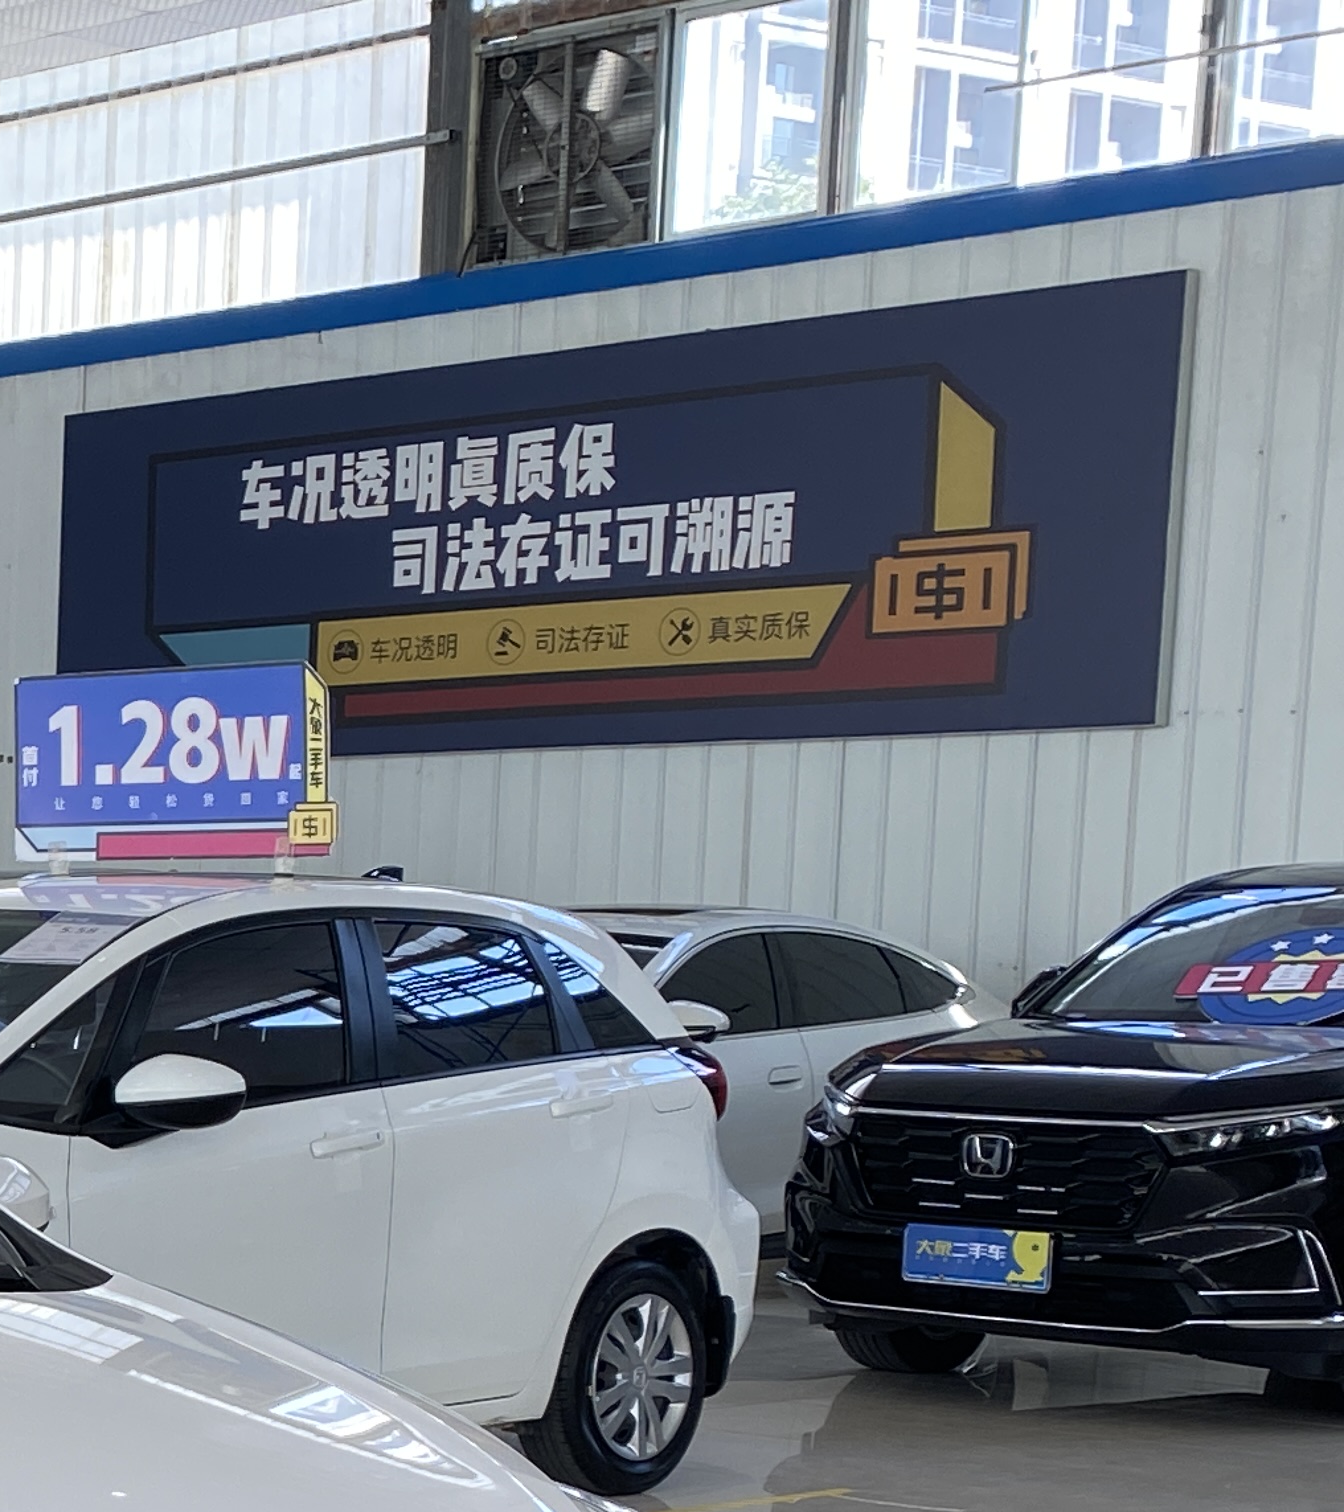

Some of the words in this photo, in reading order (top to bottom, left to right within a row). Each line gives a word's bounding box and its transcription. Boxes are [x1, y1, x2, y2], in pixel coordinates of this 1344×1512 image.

[392, 491, 797, 594] 司法存证可溯源
[369, 632, 458, 665] 车况透明
[535, 623, 630, 655] 司法存证
[707, 611, 811, 645] 真实质保
[22, 746, 39, 788] 首付
[916, 1239, 1008, 1261] 大象二手车
